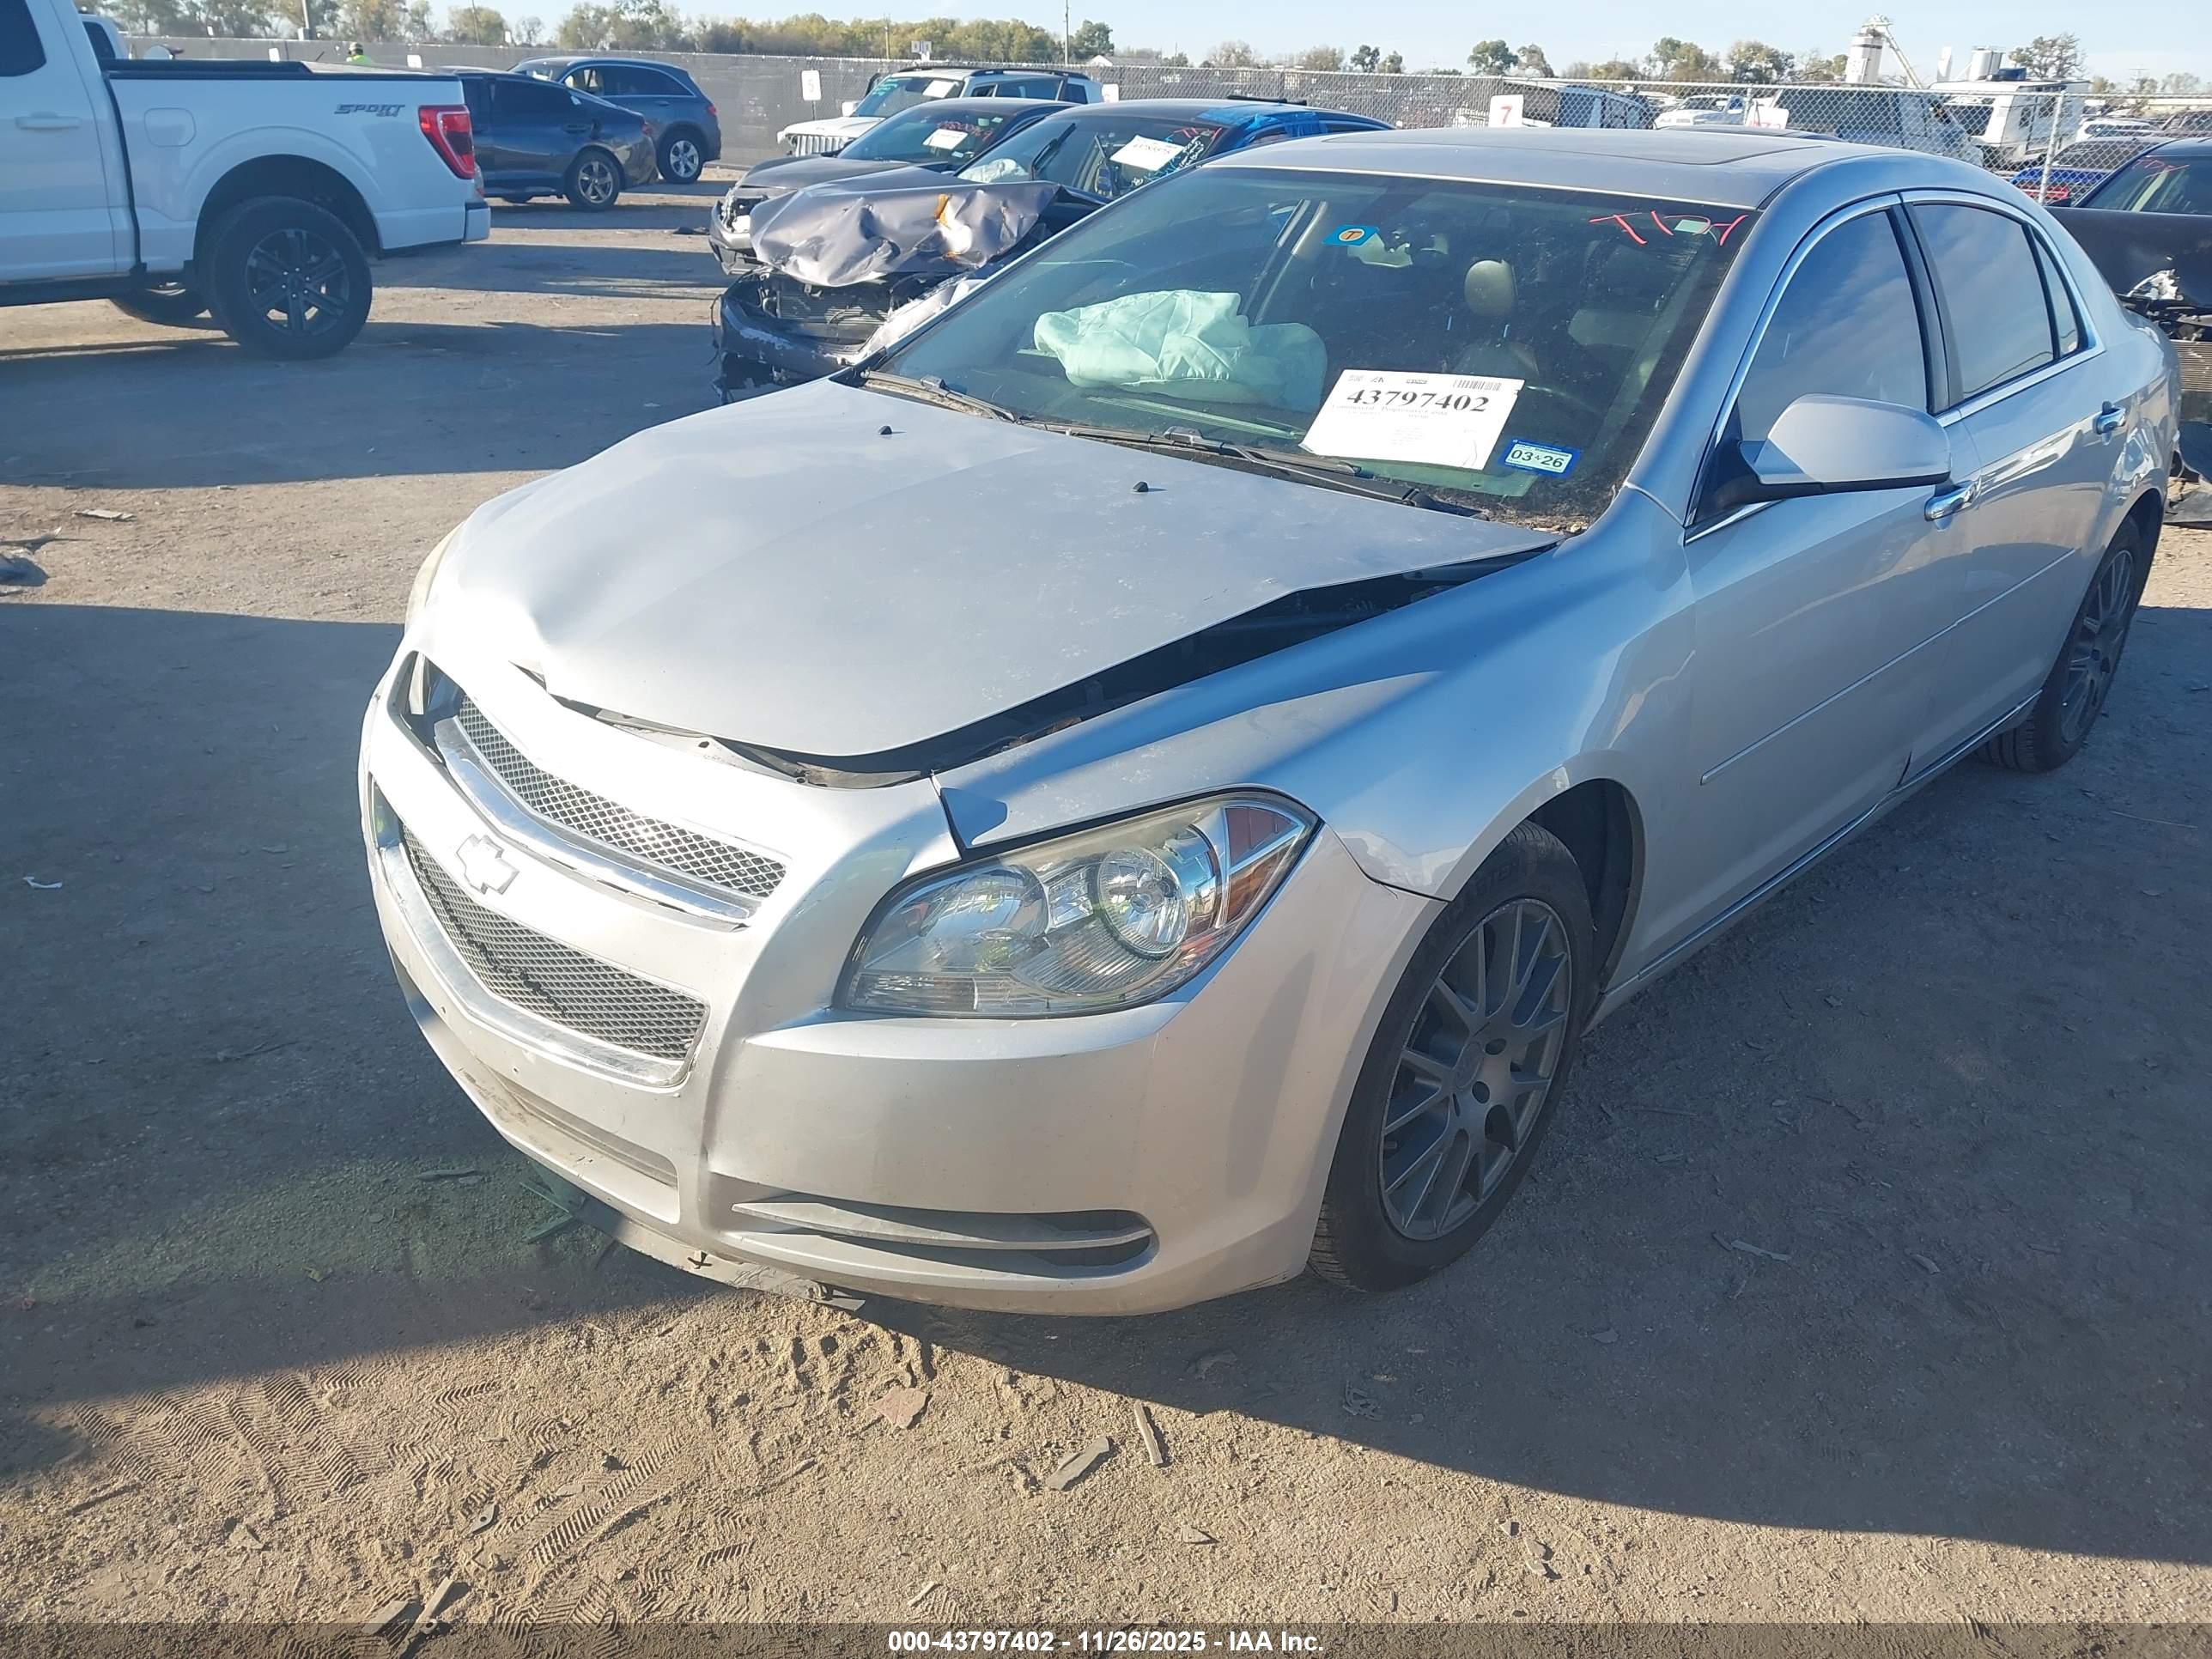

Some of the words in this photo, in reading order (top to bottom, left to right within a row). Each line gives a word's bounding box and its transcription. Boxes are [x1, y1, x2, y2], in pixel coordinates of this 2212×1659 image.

[334, 104, 405, 115] SPORT
[1500, 105, 1512, 125] 7
[1346, 389, 1489, 412] 43797402
[1510, 449, 1534, 461] 03
[1540, 455, 1565, 468] 26
